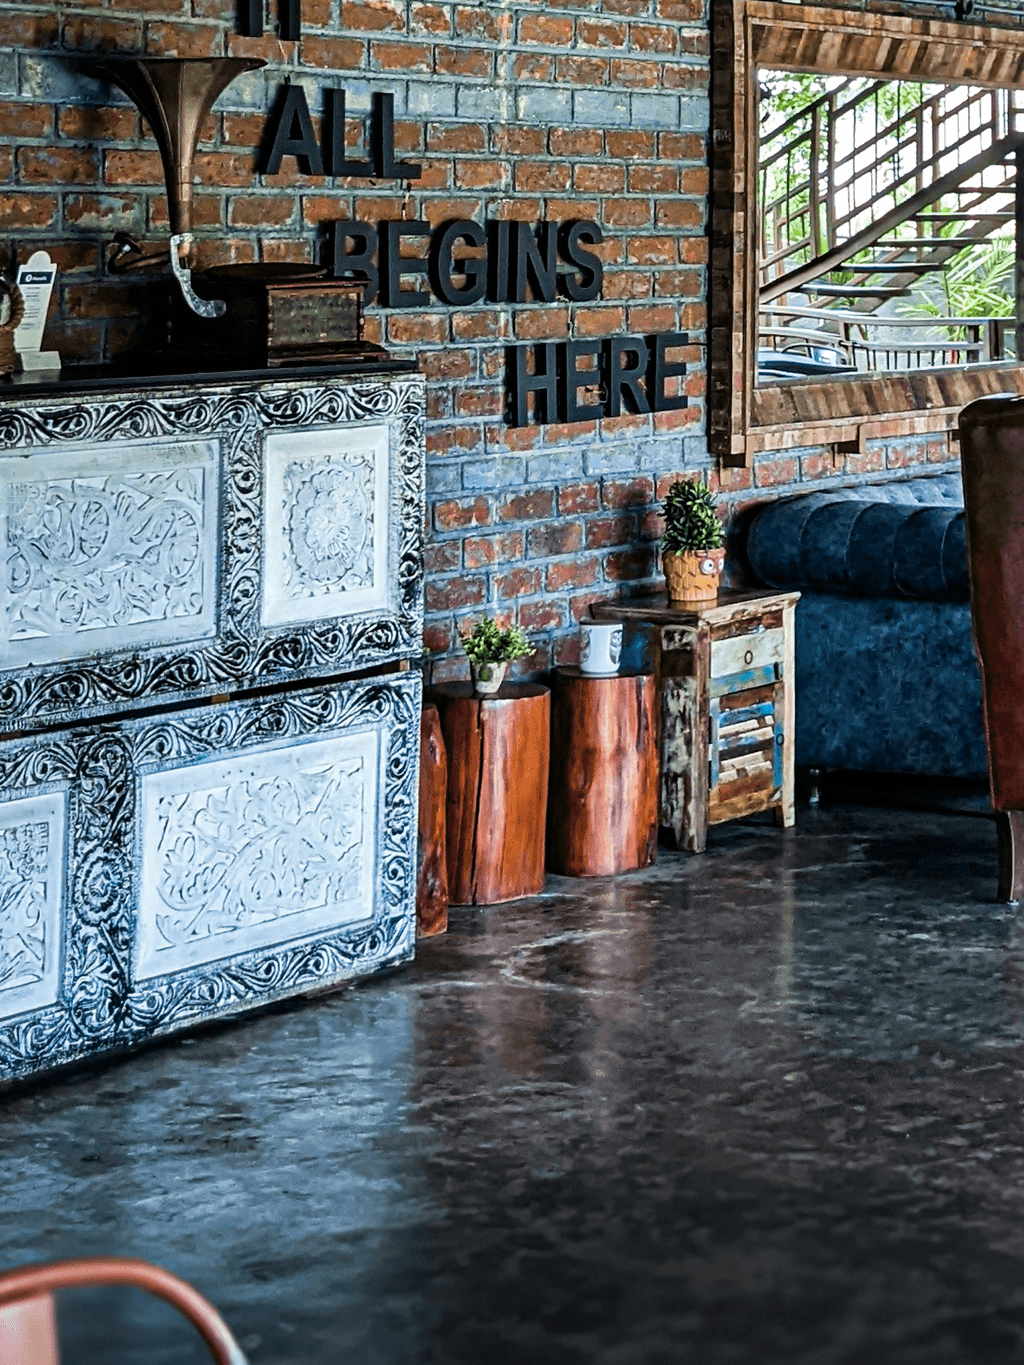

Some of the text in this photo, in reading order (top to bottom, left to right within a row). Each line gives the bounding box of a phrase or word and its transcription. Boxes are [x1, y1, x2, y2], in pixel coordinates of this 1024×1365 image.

[265, 84, 422, 179] ALL
[334, 220, 602, 307] BEGINS
[515, 333, 688, 427] HERE
